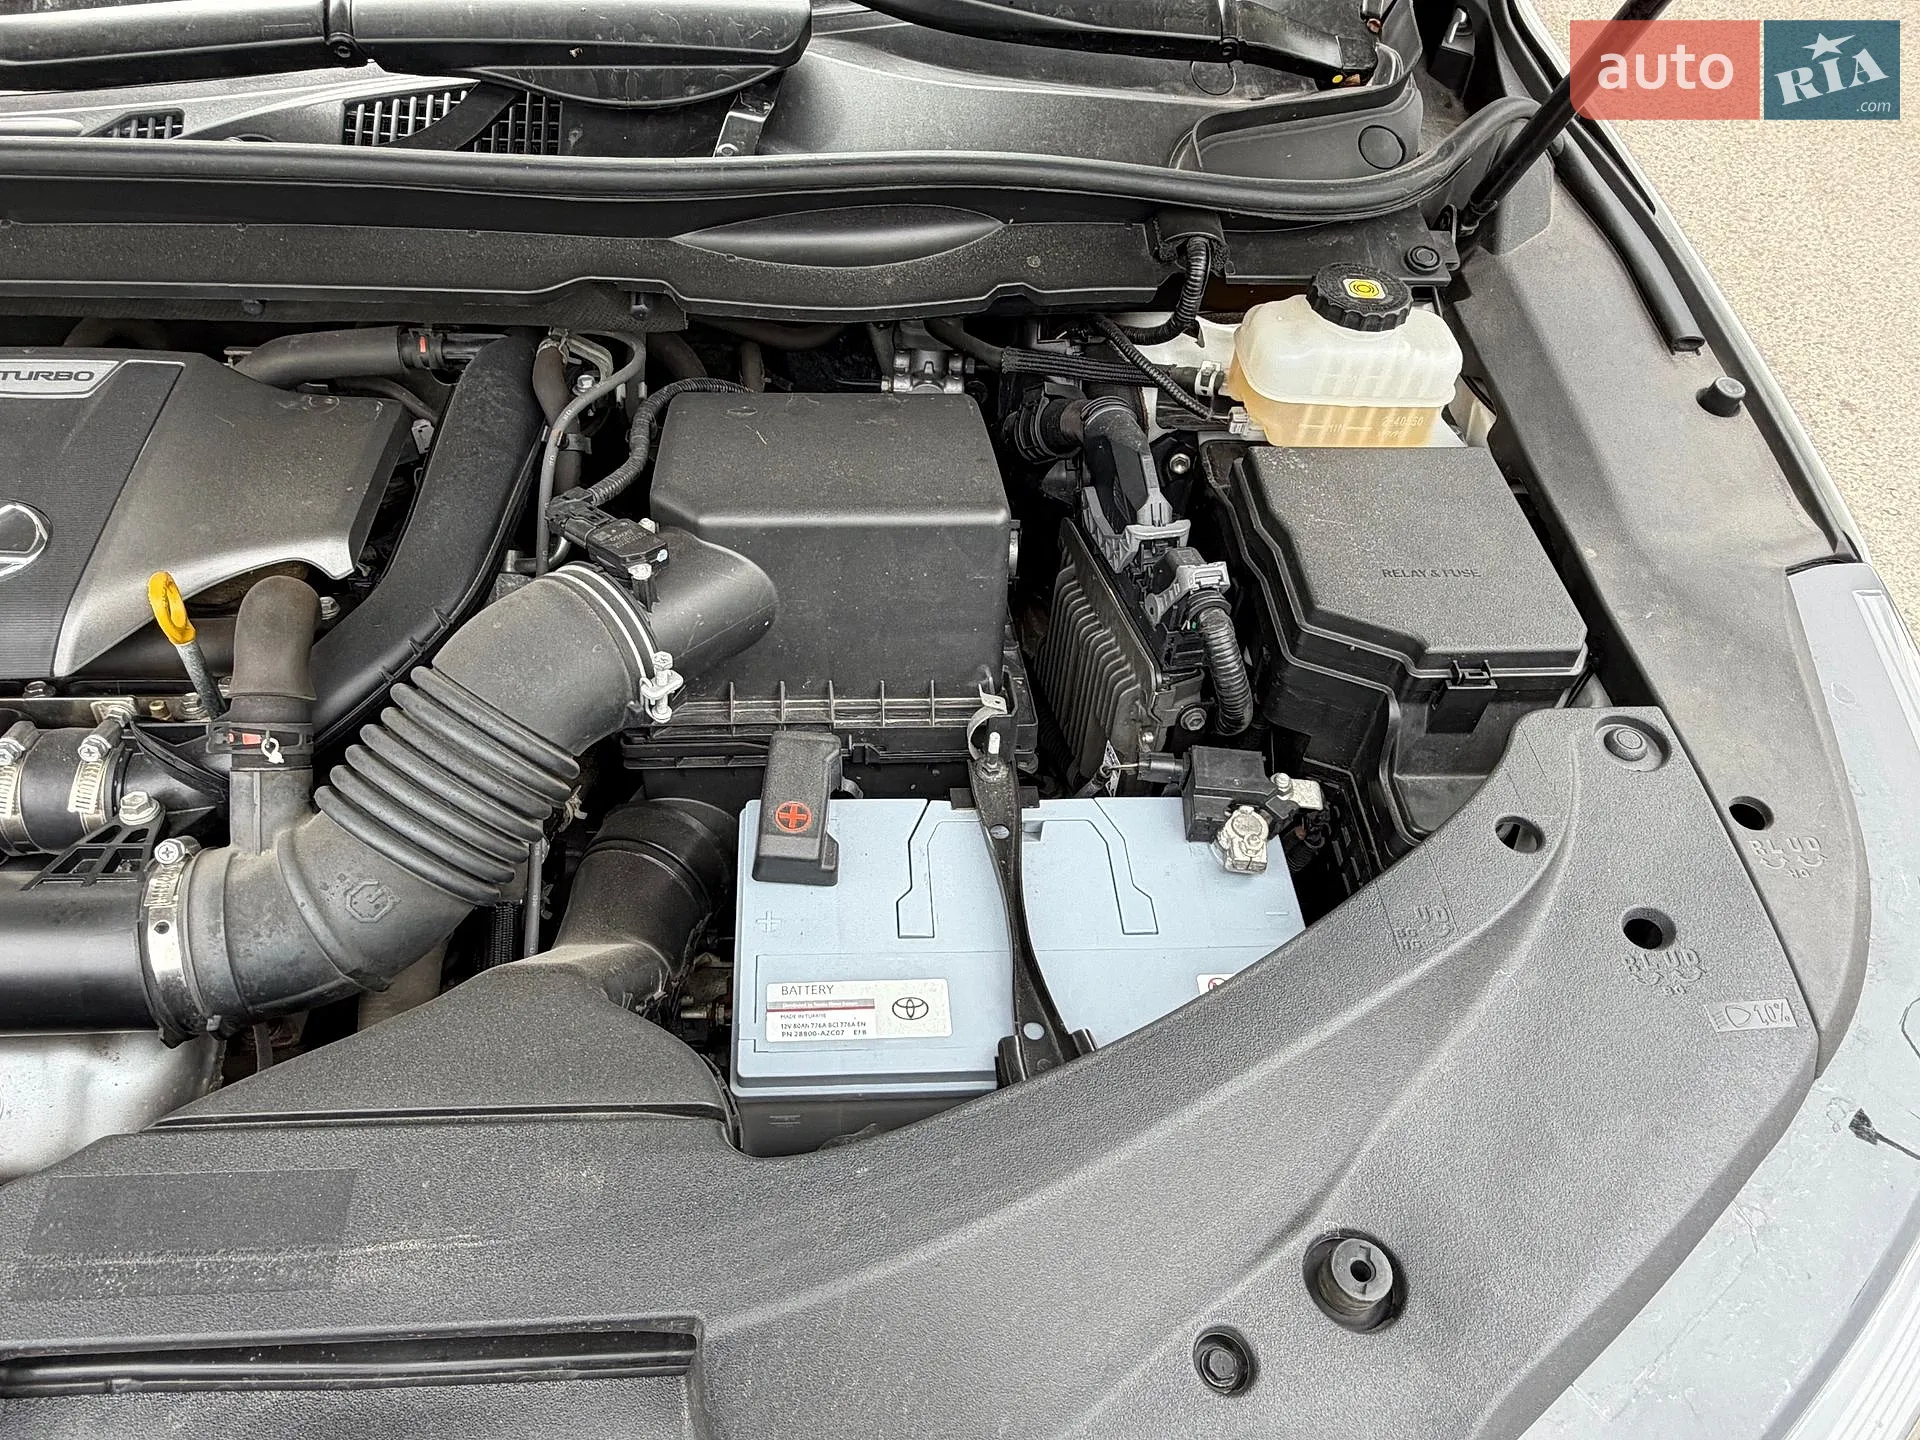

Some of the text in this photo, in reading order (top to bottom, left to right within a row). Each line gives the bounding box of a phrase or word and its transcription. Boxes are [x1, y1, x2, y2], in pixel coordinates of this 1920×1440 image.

[0, 370, 95, 382] TURBO
[1381, 568, 1482, 578] RELAY & FUSE
[781, 984, 834, 996] BATTERY
